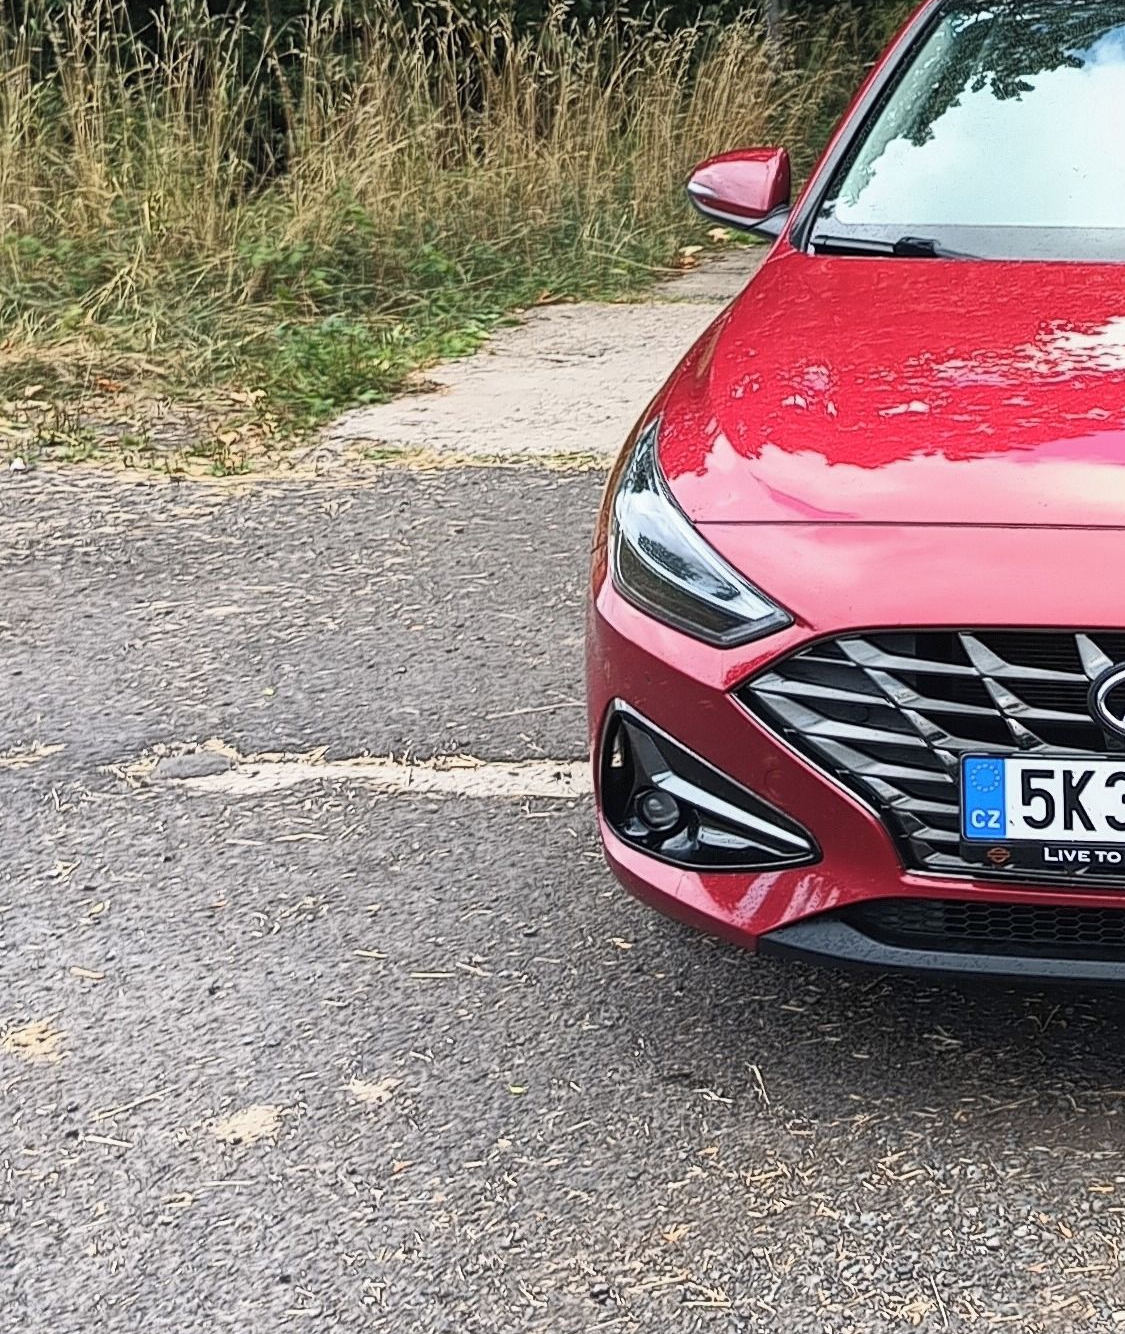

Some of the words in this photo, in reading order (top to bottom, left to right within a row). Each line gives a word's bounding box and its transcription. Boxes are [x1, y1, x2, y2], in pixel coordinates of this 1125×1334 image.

[971, 809, 1001, 829] CZ
[1043, 847, 1091, 862] LIVE
[1094, 850, 1122, 863] TO
